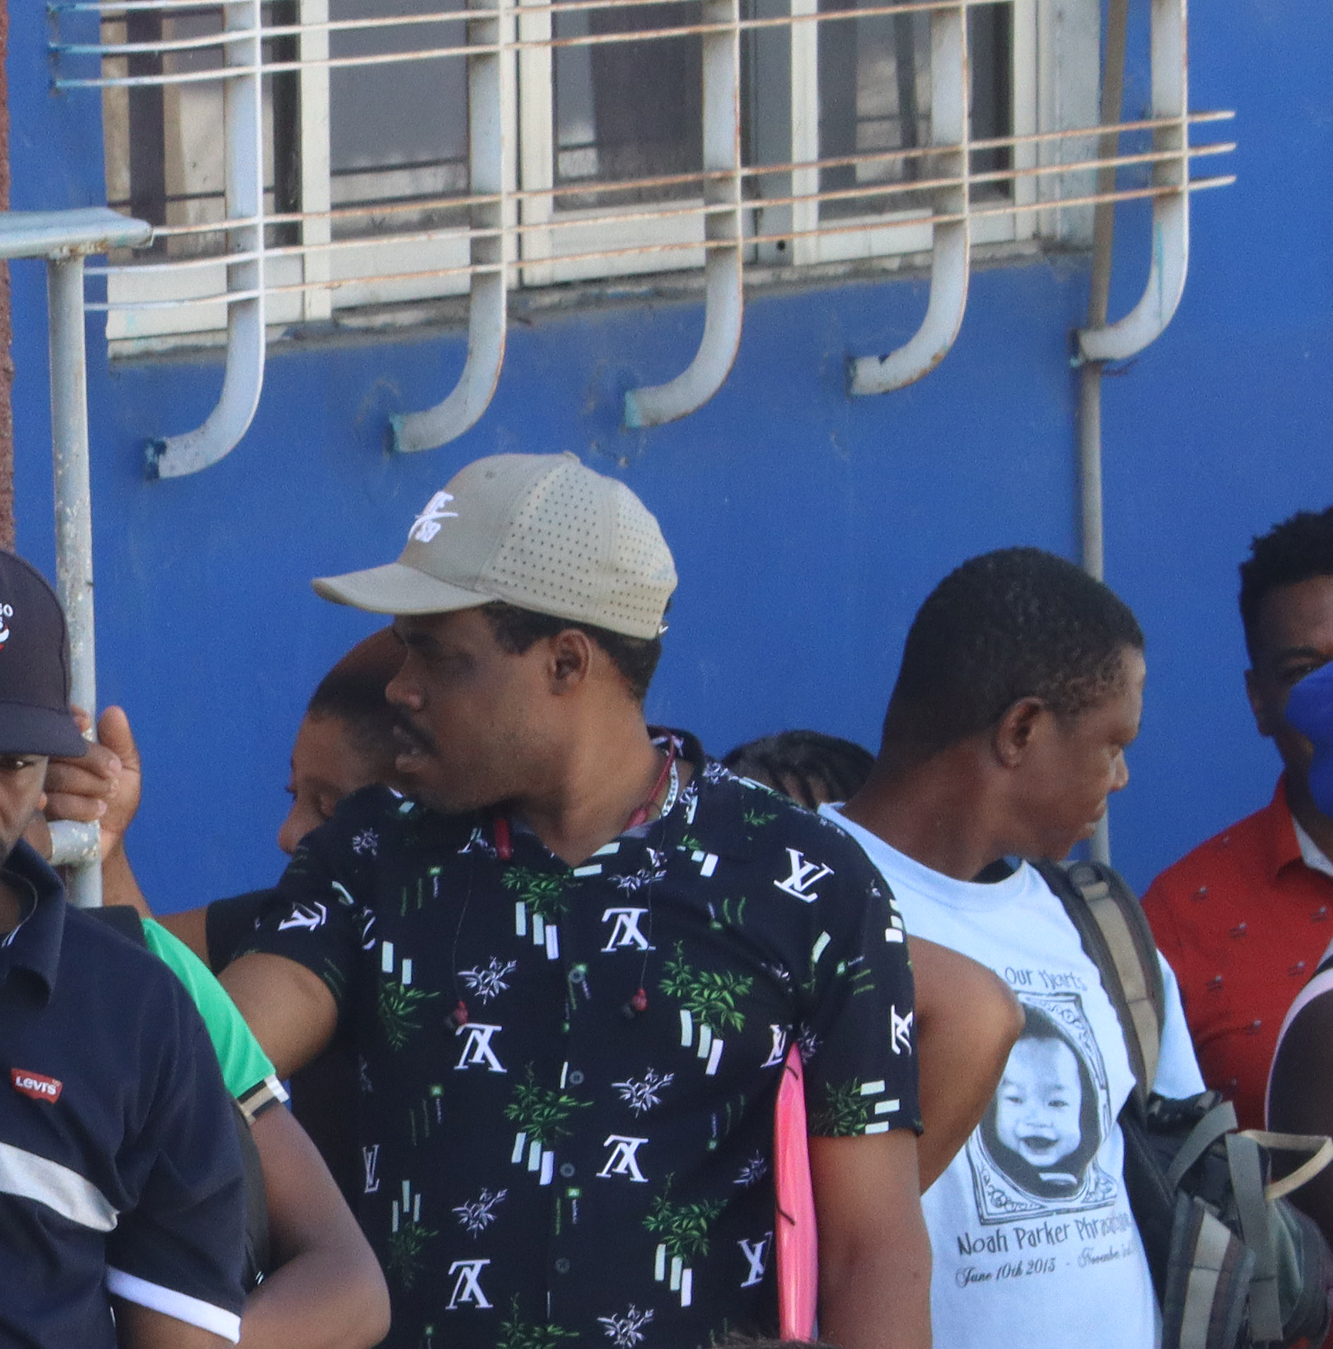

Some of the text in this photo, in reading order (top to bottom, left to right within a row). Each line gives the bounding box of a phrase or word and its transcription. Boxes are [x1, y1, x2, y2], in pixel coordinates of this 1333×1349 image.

[1004, 966, 1033, 986] Our
[956, 1231, 1009, 1256] Noah
[1013, 1221, 1071, 1250] Parker
